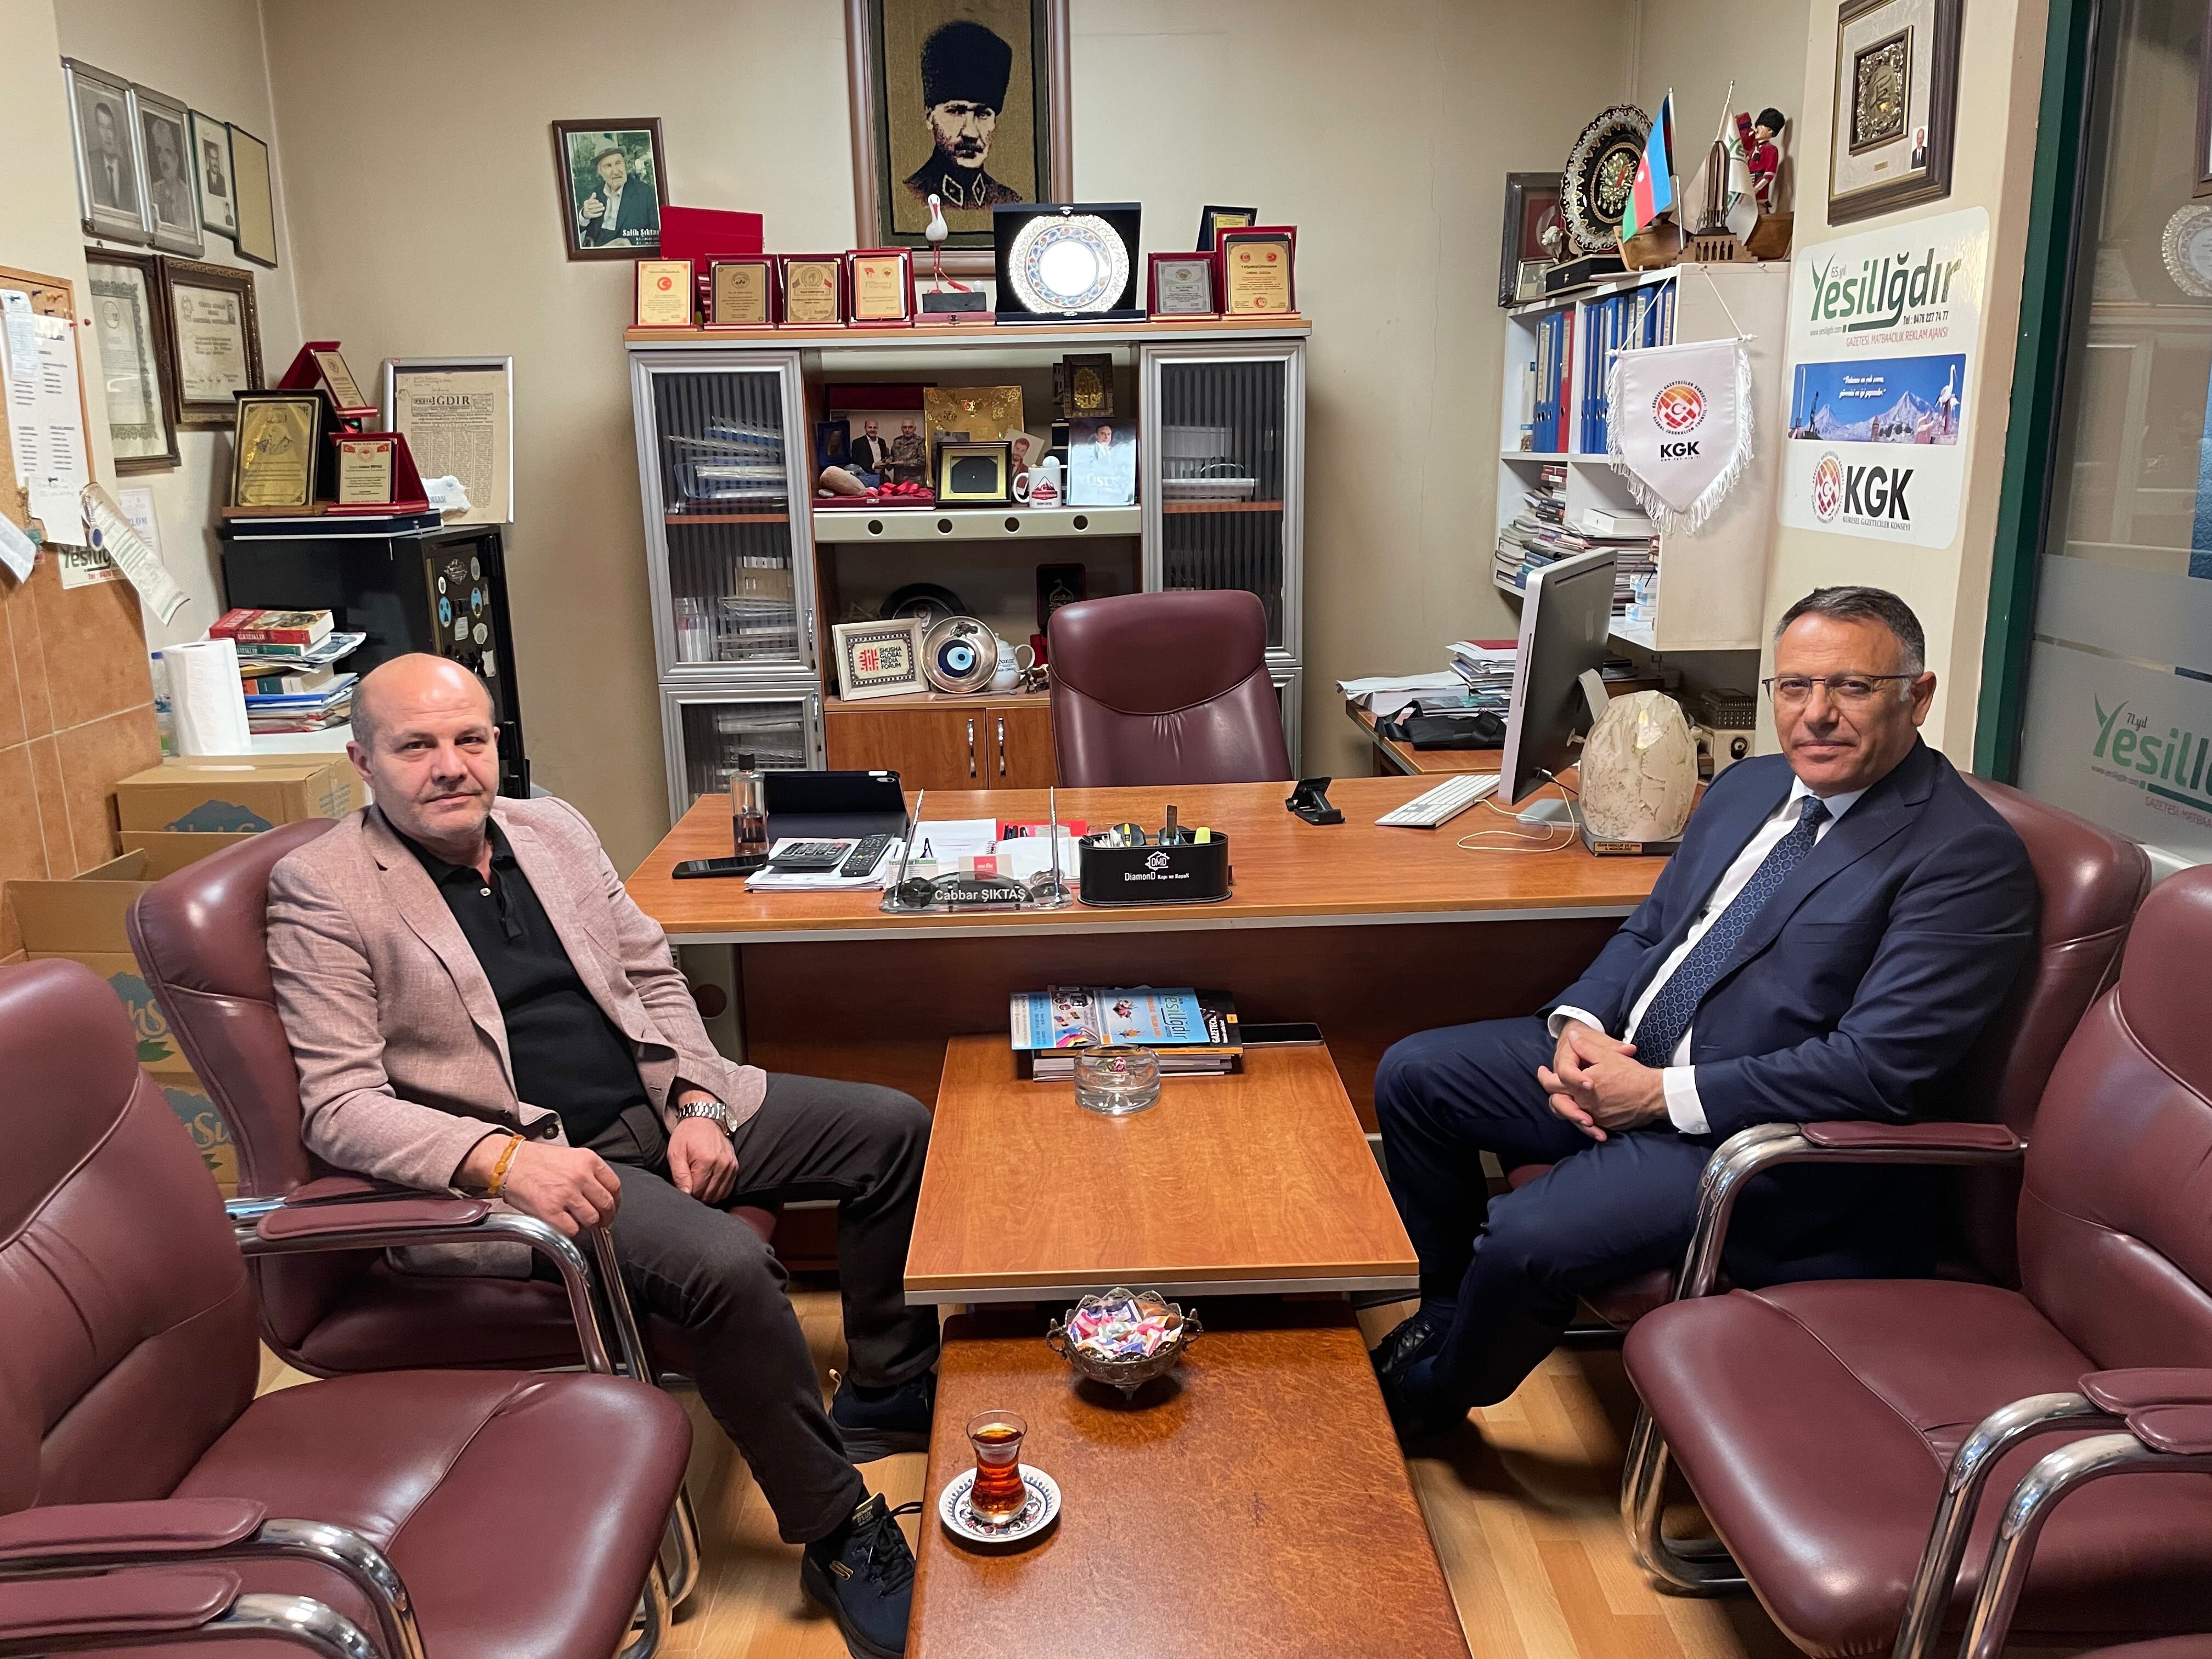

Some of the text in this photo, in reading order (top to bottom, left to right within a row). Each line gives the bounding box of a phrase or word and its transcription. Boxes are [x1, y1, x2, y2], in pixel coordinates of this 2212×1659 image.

[1925, 312, 1934, 323] 227
[1935, 311, 1942, 321] 74
[1942, 311, 1949, 320] 77
[1905, 329, 1928, 341] REKLAM
[1928, 327, 1949, 341] AJANSI
[1660, 441, 1700, 458] KGK
[1844, 466, 1914, 521] KGK
[1125, 871, 1156, 882] DiamonD
[935, 889, 1026, 902] Cabbar ŞIKTAŞ
